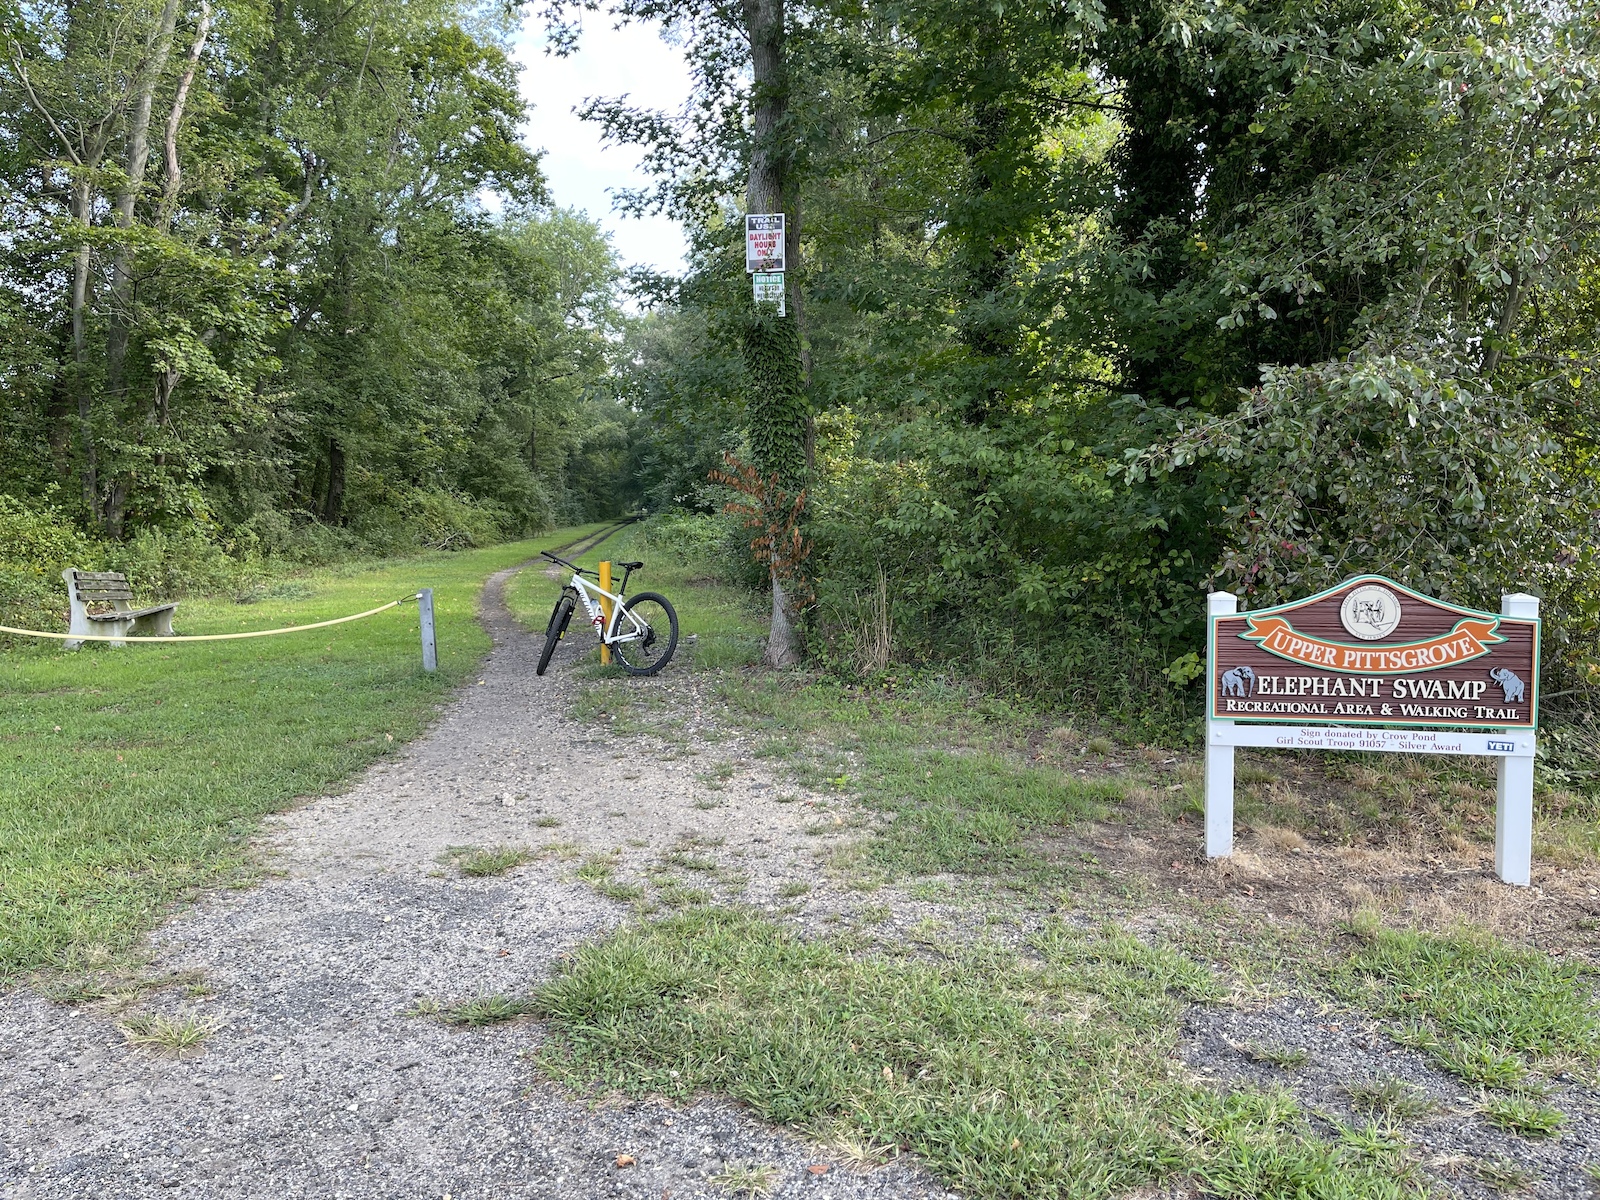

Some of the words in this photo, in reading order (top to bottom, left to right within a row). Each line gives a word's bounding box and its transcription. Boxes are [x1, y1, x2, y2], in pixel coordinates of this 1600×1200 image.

[756, 275, 782, 283] NOTICE
[1273, 631, 1337, 666] UPPER
[1342, 636, 1475, 669] PITTSGROVE
[1257, 675, 1384, 698] ELEPHANT
[1392, 678, 1487, 701] SWAMP
[1226, 698, 1328, 714] RECREATIONAL
[1333, 701, 1374, 716] AREA
[1380, 703, 1393, 716] &
[1399, 703, 1468, 719] WALKING
[1474, 705, 1520, 720] TRAIL
[1300, 728, 1321, 740] Sign
[1324, 729, 1362, 739] donated
[1366, 731, 1379, 742] by
[1382, 731, 1409, 741] Crow
[1412, 732, 1436, 742] Pond
[1276, 736, 1294, 745] Girl
[1297, 737, 1323, 746] Scout
[1326, 738, 1355, 748] Troop
[1359, 740, 1387, 749] 91057
[1398, 741, 1427, 750] Silver
[1430, 742, 1462, 752] Award
[1488, 742, 1513, 751] YETI
